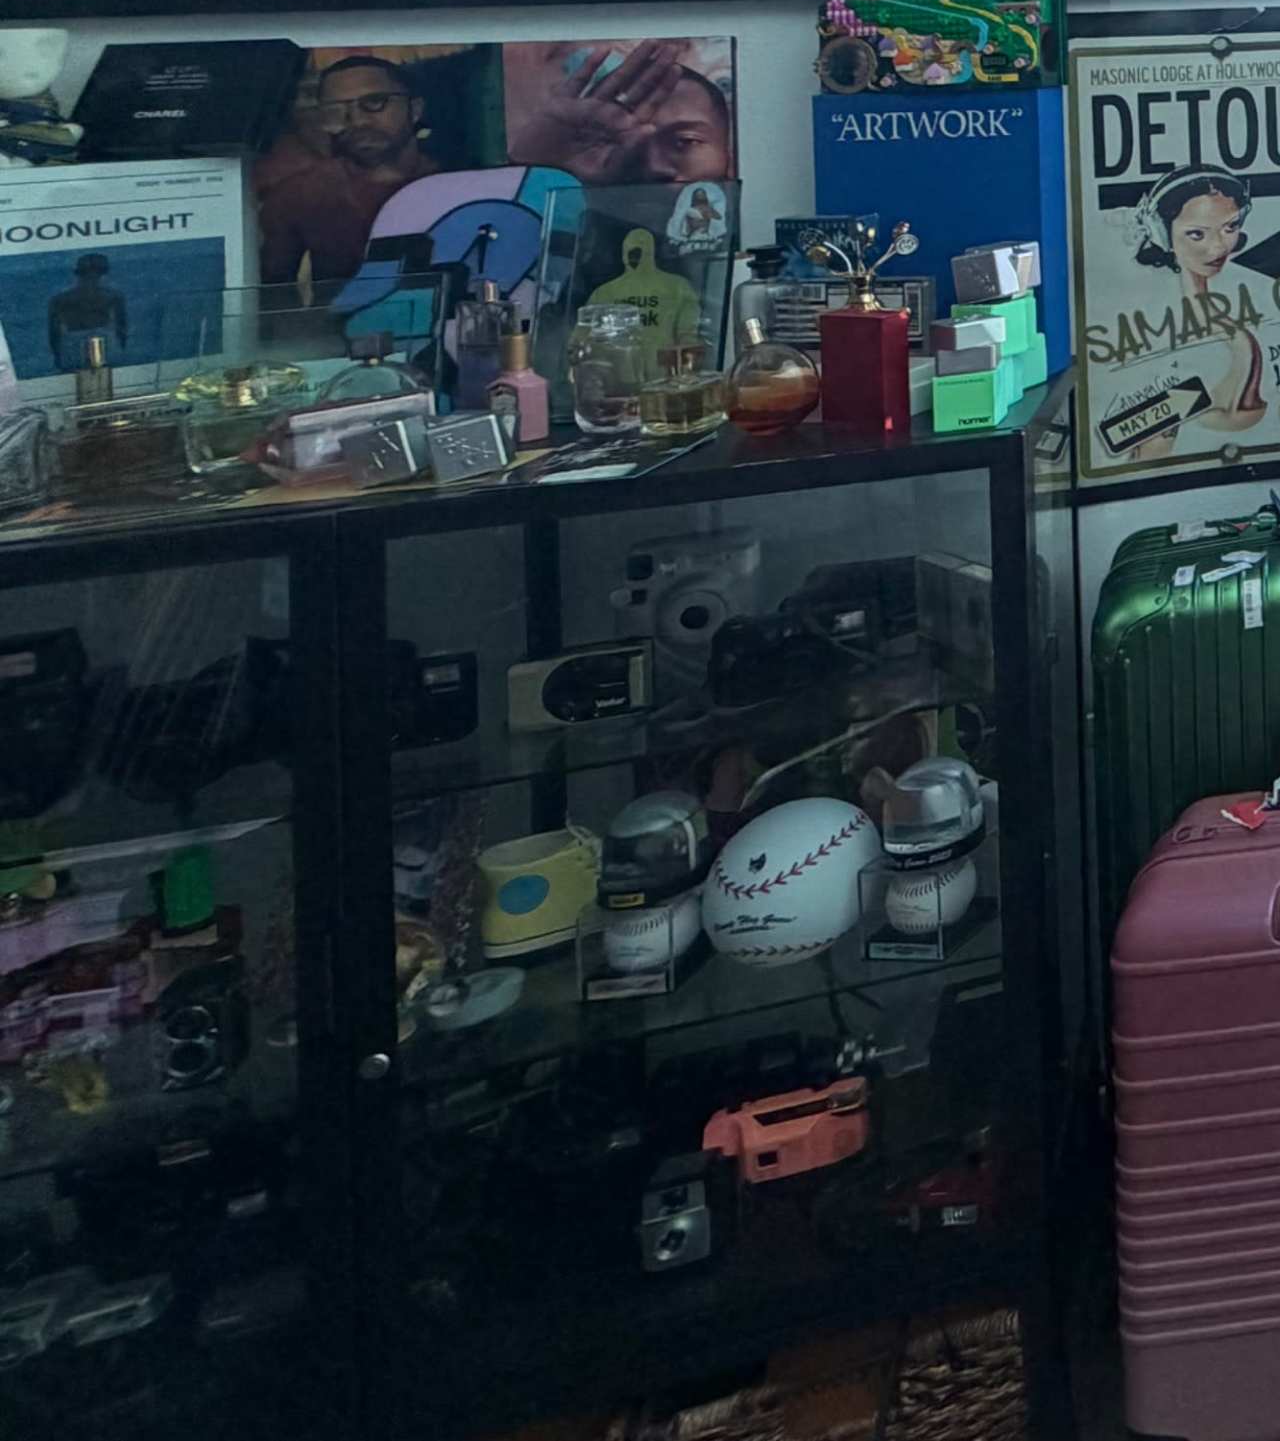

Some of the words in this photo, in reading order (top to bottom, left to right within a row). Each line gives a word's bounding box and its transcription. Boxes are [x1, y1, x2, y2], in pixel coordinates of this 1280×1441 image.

[1090, 67, 1149, 86] MASONIC
[1153, 65, 1193, 82] LODGE
[1196, 64, 1212, 80] AT
[1084, 283, 1264, 364] SAMARA
[1119, 414, 1147, 437] MAY
[1154, 403, 1171, 421] 20
